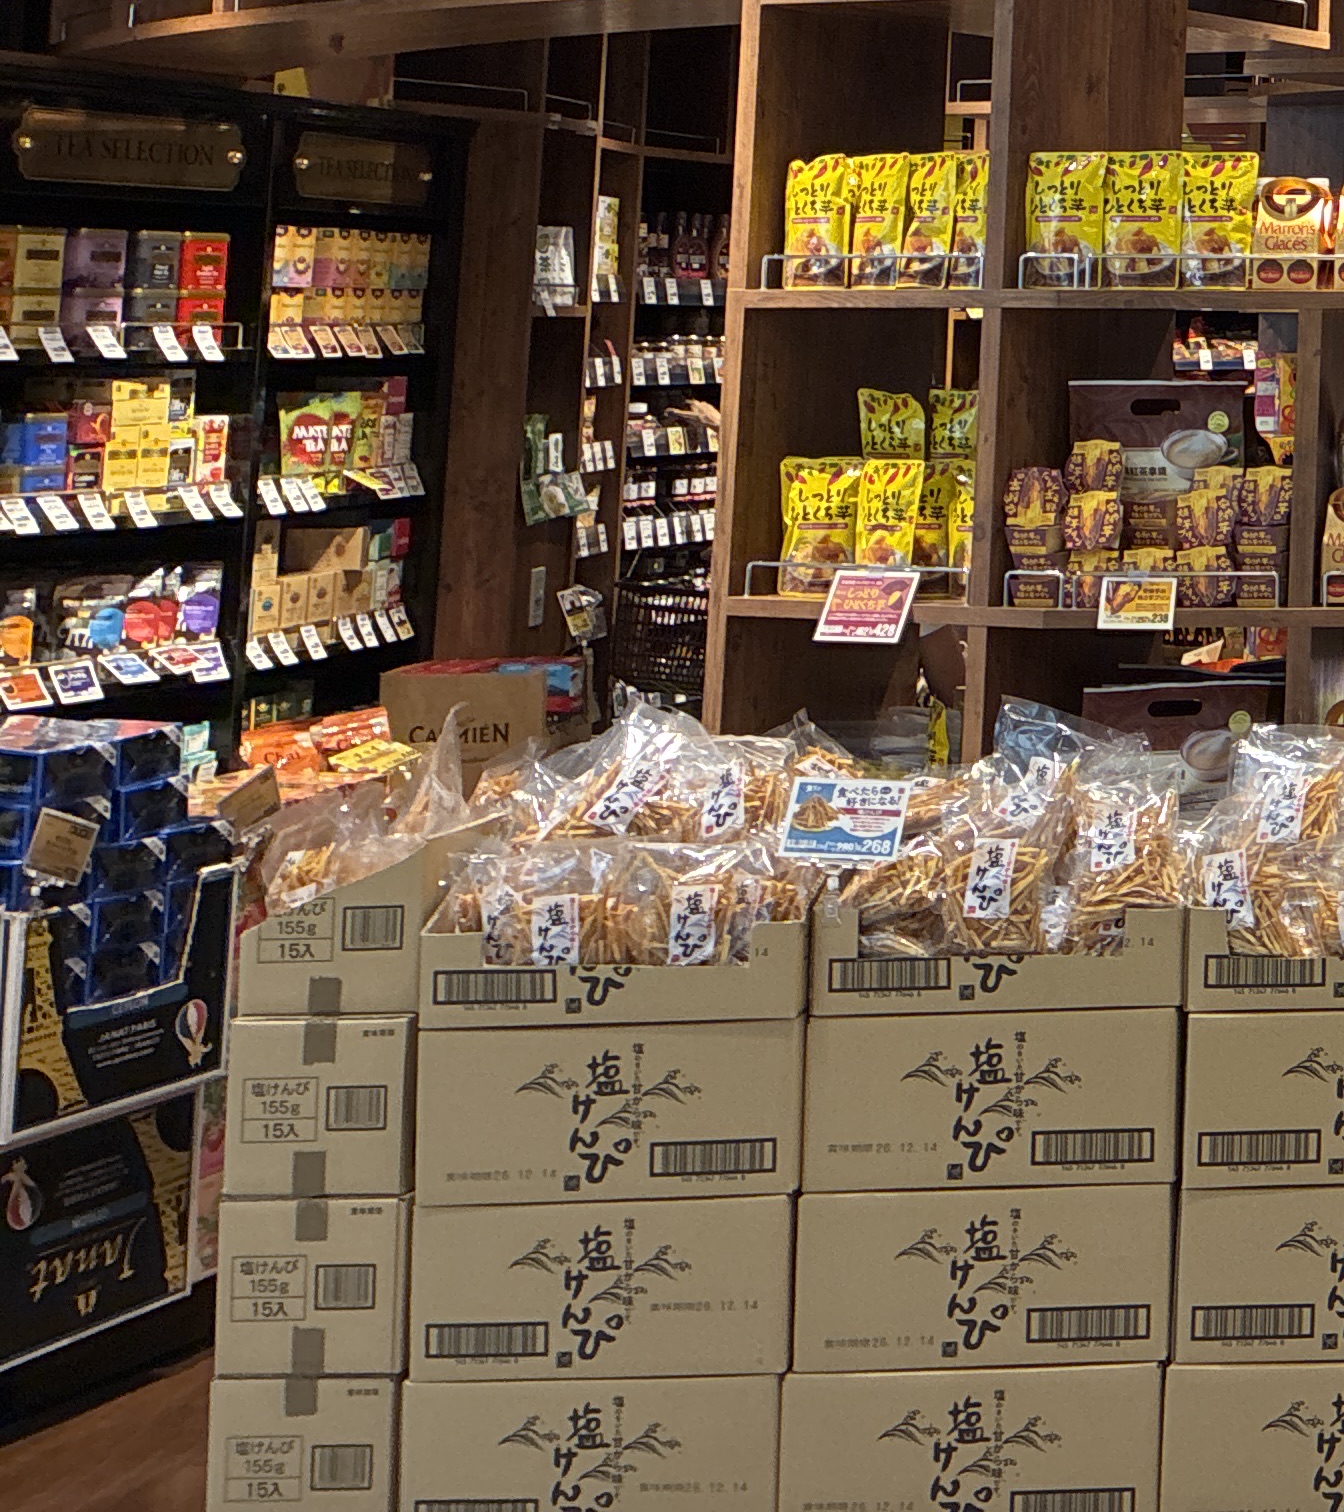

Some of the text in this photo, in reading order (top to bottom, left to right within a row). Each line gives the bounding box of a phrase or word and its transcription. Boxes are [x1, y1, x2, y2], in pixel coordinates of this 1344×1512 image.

[56, 134, 215, 166] TEA SELECTION
[1111, 180, 1161, 195] しっとり
[1104, 199, 1166, 214] ひとくち芋
[1187, 198, 1237, 213] とくち芋
[1260, 222, 1316, 236] Marrons
[291, 425, 326, 441] MATE
[862, 839, 891, 854] 268
[972, 847, 1005, 911] 塩けんぴ
[277, 921, 316, 935] 155g
[673, 892, 709, 958] 塩けんぴ
[280, 944, 314, 959] 15入
[261, 1100, 300, 1116] 155g
[953, 1037, 1014, 1173] 塩けんぴ
[569, 1050, 632, 1184] 塩けんぴ
[263, 1123, 299, 1138] 15入
[249, 1278, 289, 1295] 155g
[947, 1215, 1010, 1350] 塩けんぴ
[563, 1225, 624, 1360] 塩けんぴ
[252, 1300, 289, 1319] 15入
[244, 1458, 285, 1475] 155g
[246, 1480, 284, 1500] 15入
